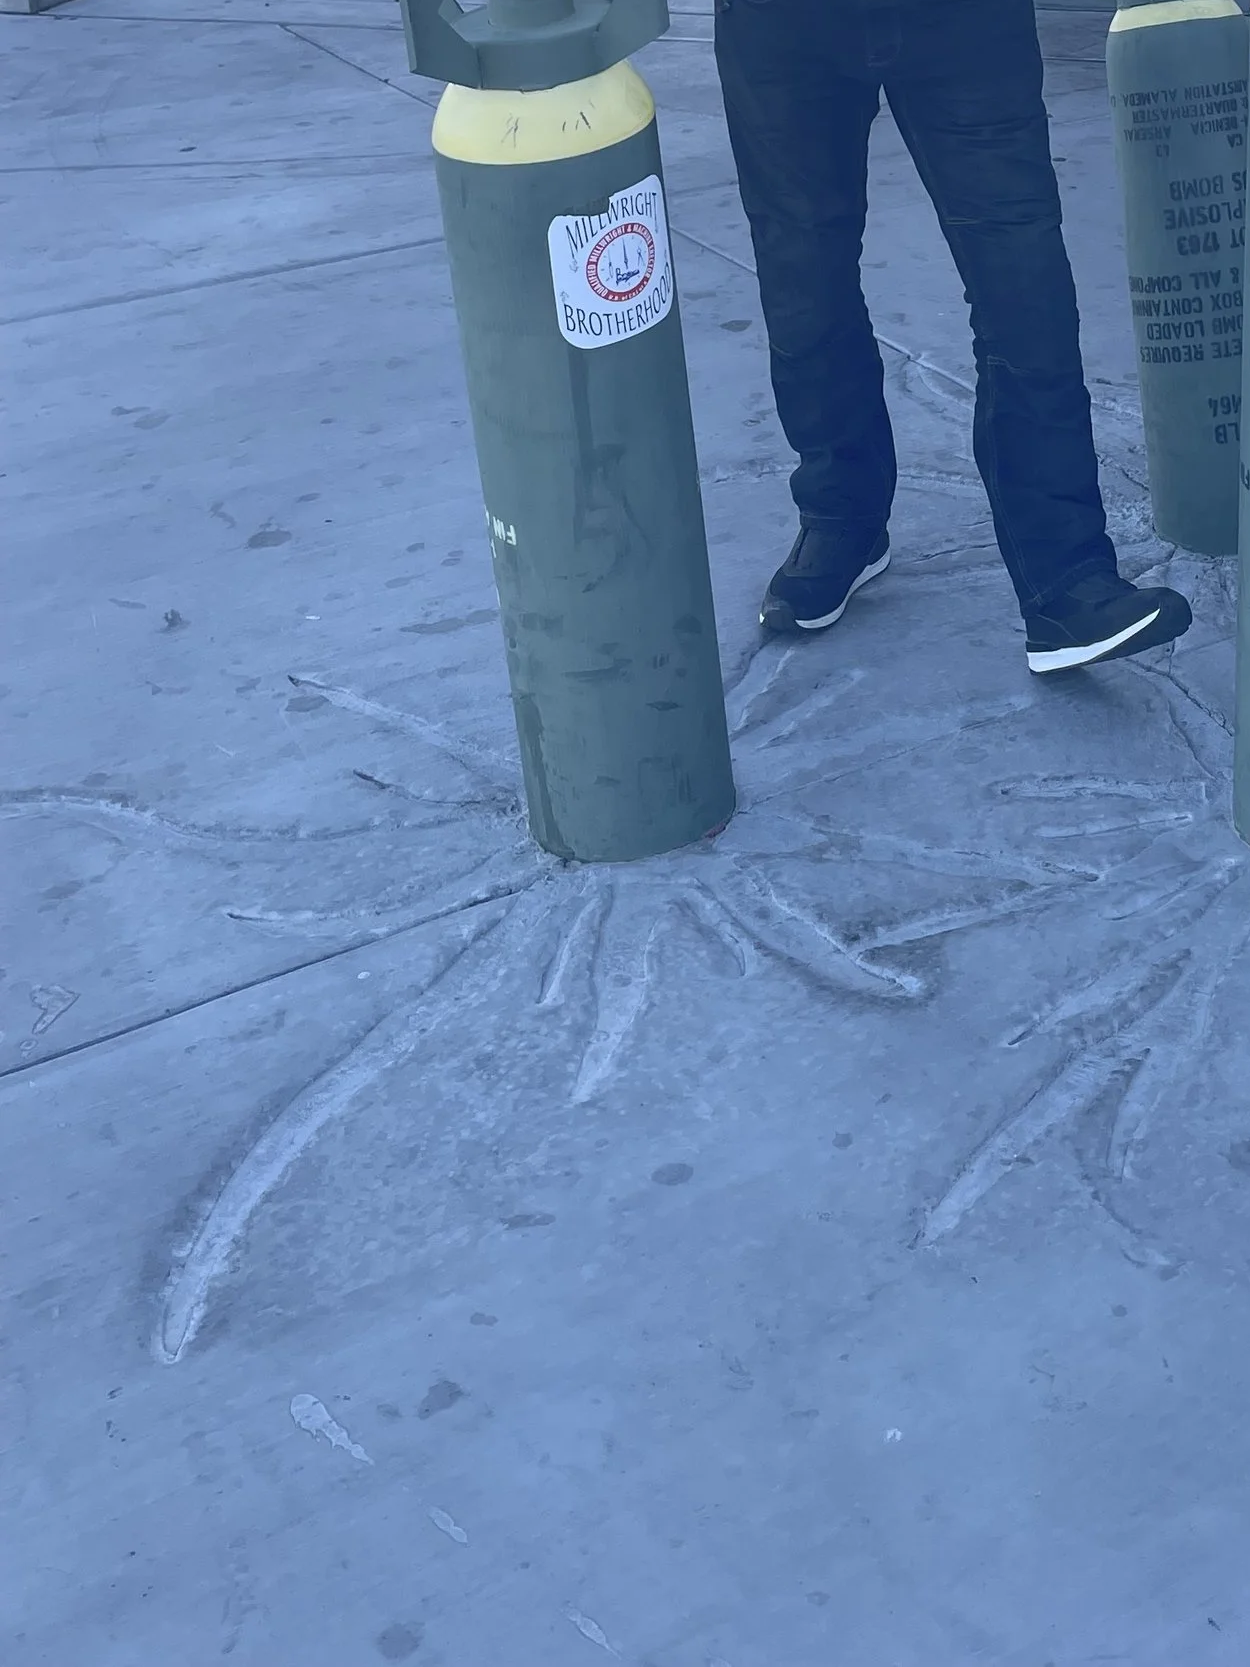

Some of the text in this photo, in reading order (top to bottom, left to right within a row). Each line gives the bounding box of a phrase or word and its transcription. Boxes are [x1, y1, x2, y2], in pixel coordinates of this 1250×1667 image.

[1122, 87, 1178, 108] ALAMEDA
[1131, 98, 1238, 124] QUARTERMASTER
[1168, 174, 1224, 202] BOMB
[565, 192, 659, 259] MILLWRIGHT
[1163, 198, 1246, 230] PLOSIVE
[588, 223, 626, 263] MILLWRIGHT
[1188, 269, 1221, 290] ALL
[563, 262, 672, 336] BROTHERHOOD
[1209, 289, 1243, 312] BOX
[1146, 319, 1205, 341] LOADED
[1139, 343, 1204, 364] REQUIRES
